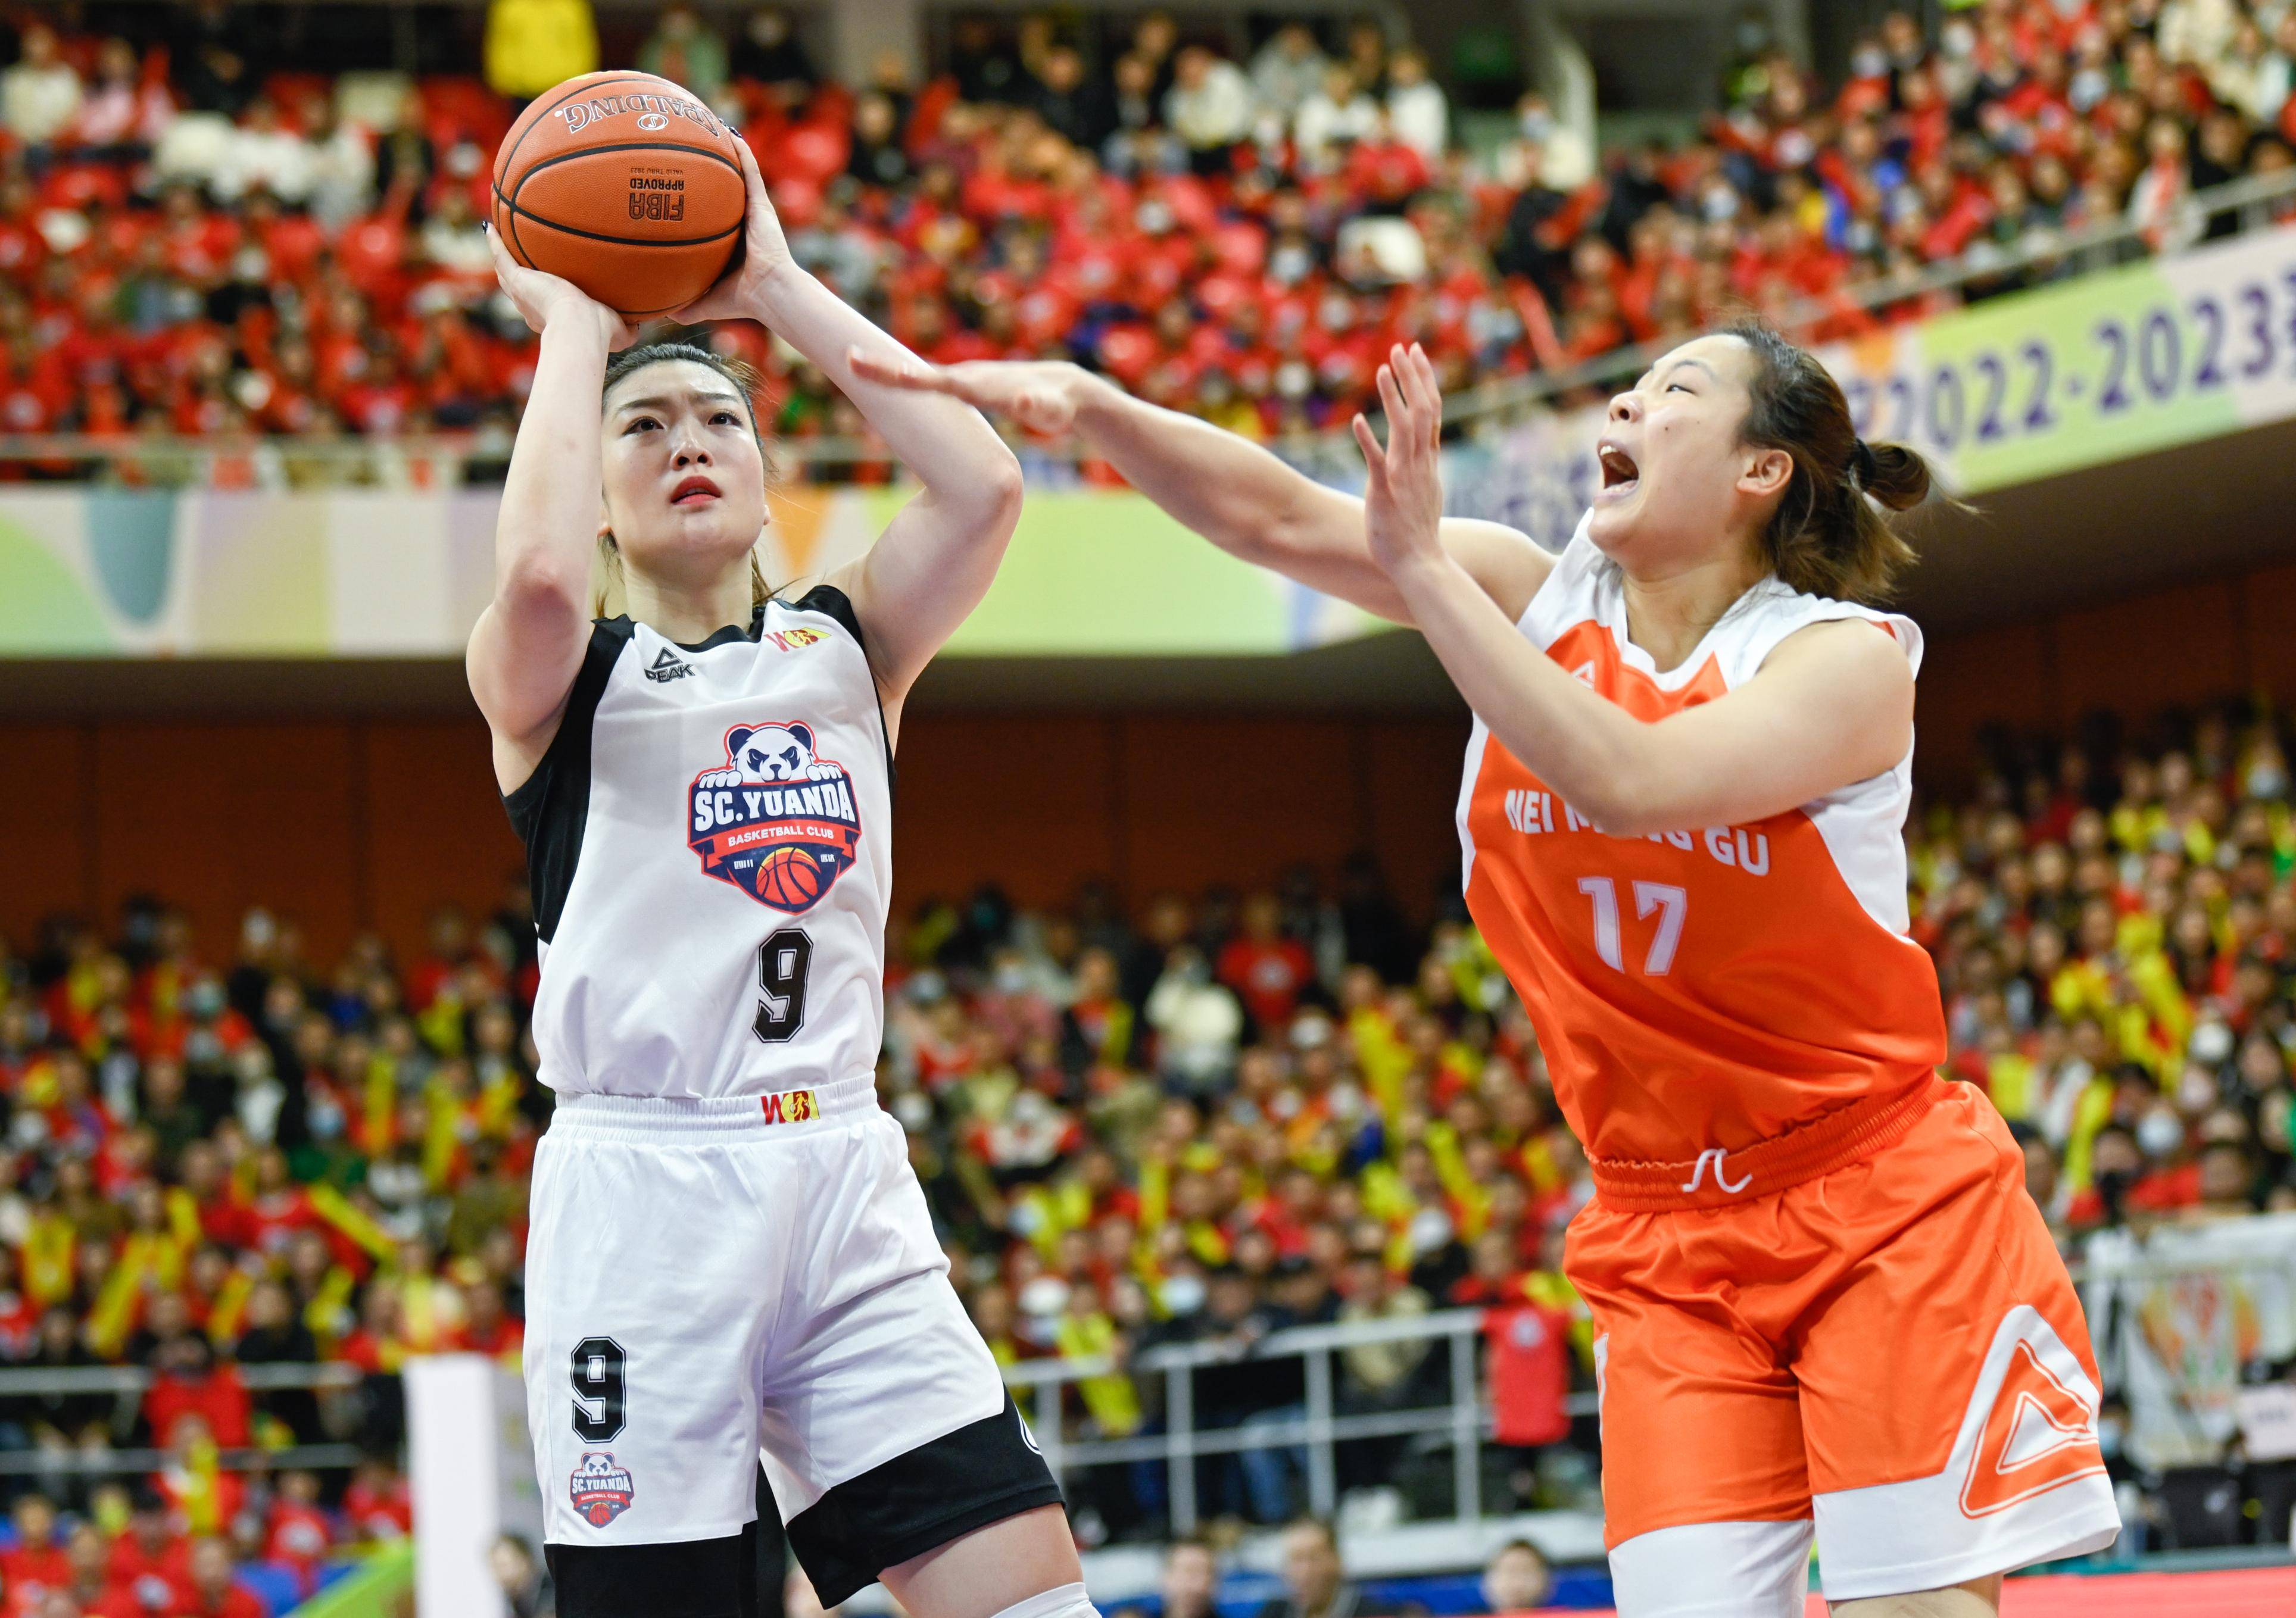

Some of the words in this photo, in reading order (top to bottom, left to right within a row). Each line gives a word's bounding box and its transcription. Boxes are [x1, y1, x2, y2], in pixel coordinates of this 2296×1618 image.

[629, 177, 685, 190] APPROVED
[629, 192, 684, 221] FIBA
[643, 663, 696, 684] PEAK
[694, 780, 856, 832] SC.YUANDA
[728, 825, 804, 847] BASKETBALL
[806, 826, 835, 839] CLUB
[1505, 789, 1555, 834] NEI
[1704, 825, 1771, 876] GU
[1577, 876, 1687, 977] 17
[751, 928, 814, 1044] 9
[570, 1336, 626, 1444] 9
[572, 1475, 632, 1494] SC.YUANDA
